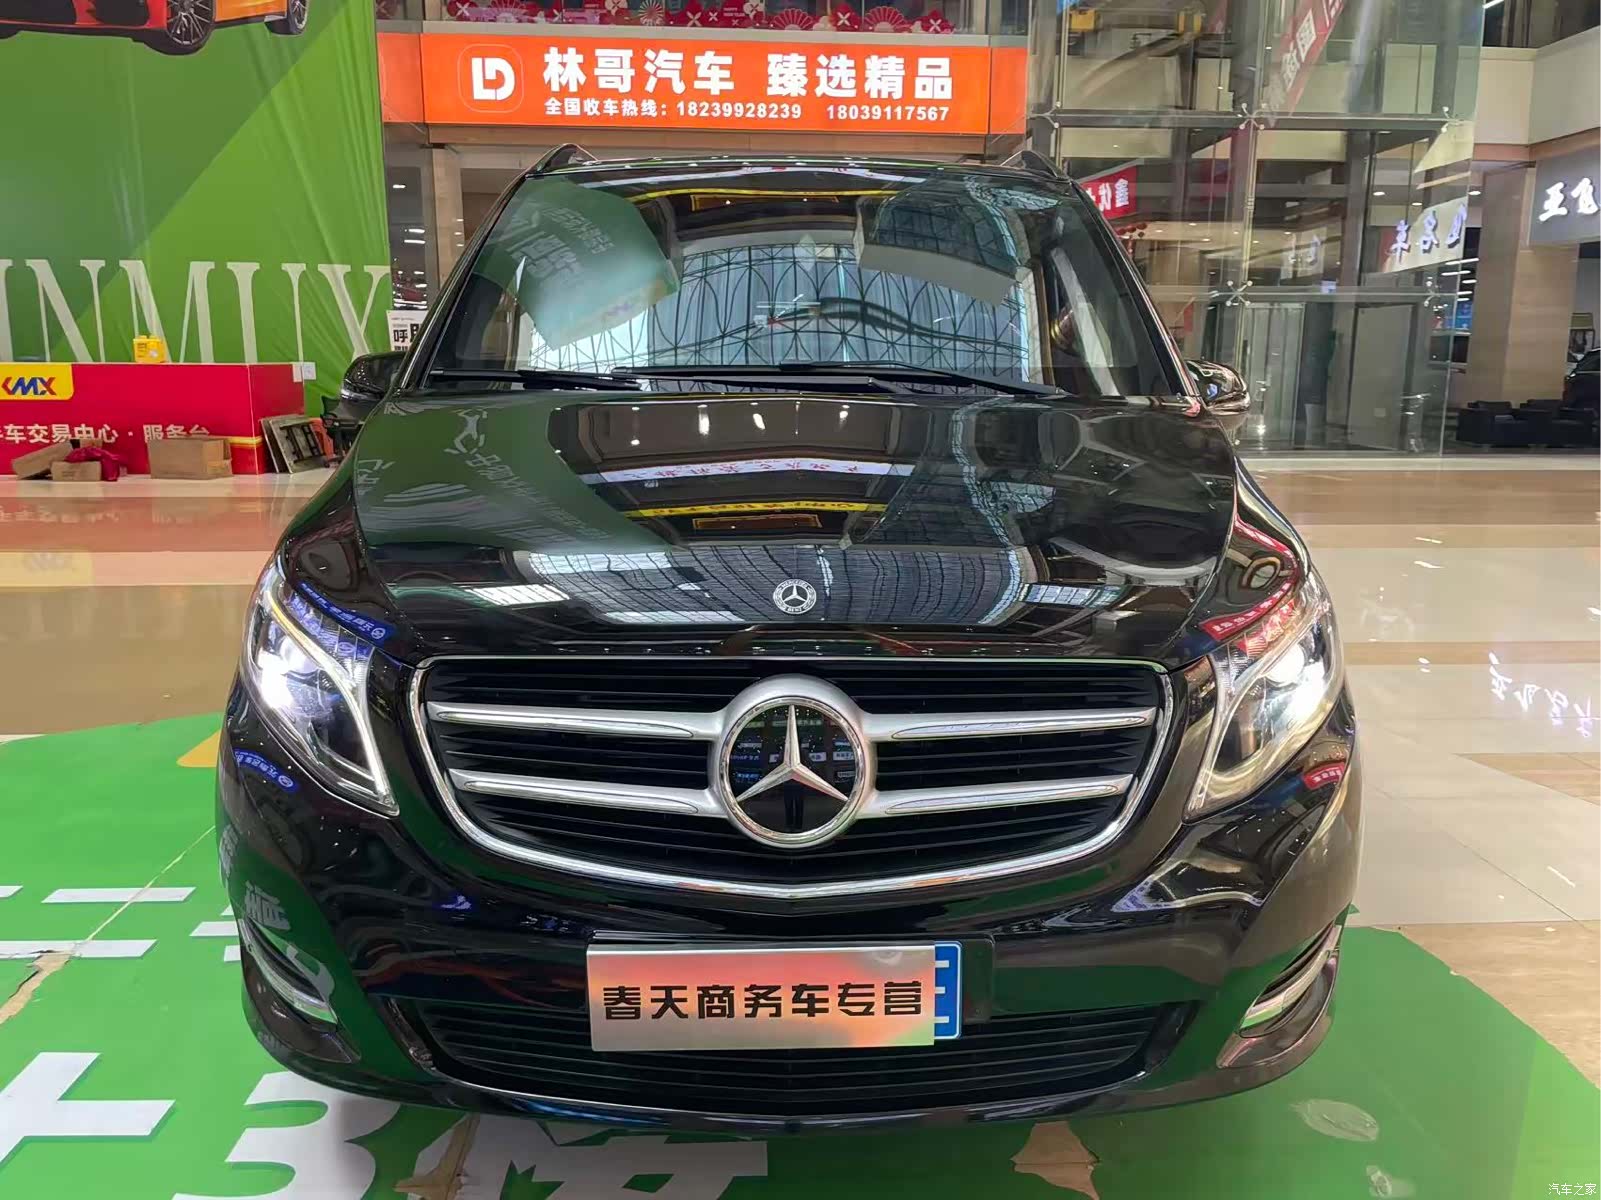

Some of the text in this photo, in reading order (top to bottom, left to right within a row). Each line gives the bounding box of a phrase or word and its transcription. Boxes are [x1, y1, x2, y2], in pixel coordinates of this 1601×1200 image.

[543, 47, 953, 100] 林哥汽车 臻选精品
[677, 101, 802, 119] 18239928239
[826, 104, 950, 121] 18039117567
[602, 980, 922, 1020] 春天商务车专营
